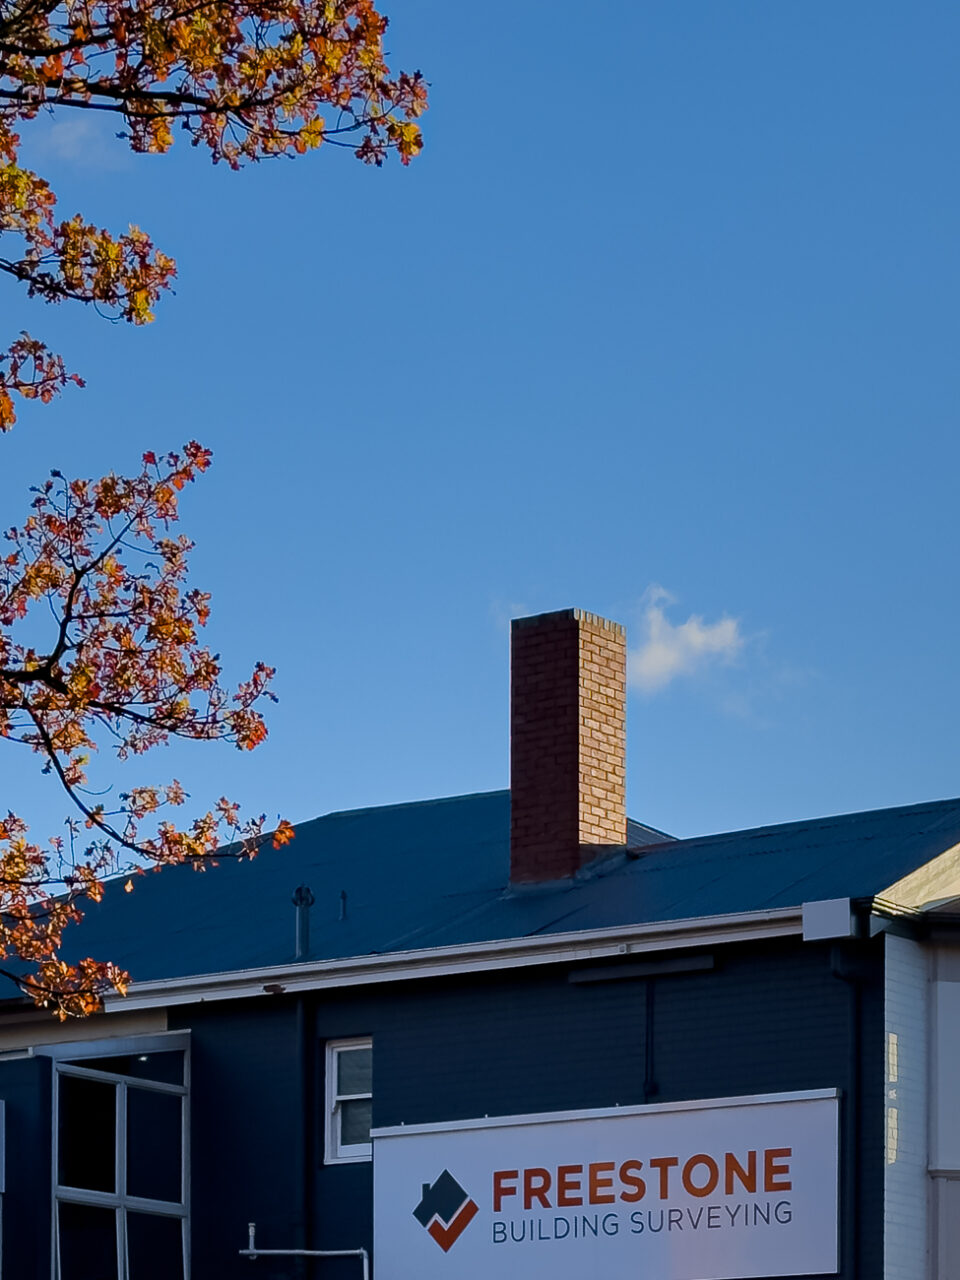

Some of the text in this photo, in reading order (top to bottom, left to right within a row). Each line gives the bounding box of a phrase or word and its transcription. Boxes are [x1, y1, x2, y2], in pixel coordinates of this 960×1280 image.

[493, 1147, 793, 1212] FREESTONE
[493, 1200, 793, 1244] BUILDING SURVEYING
